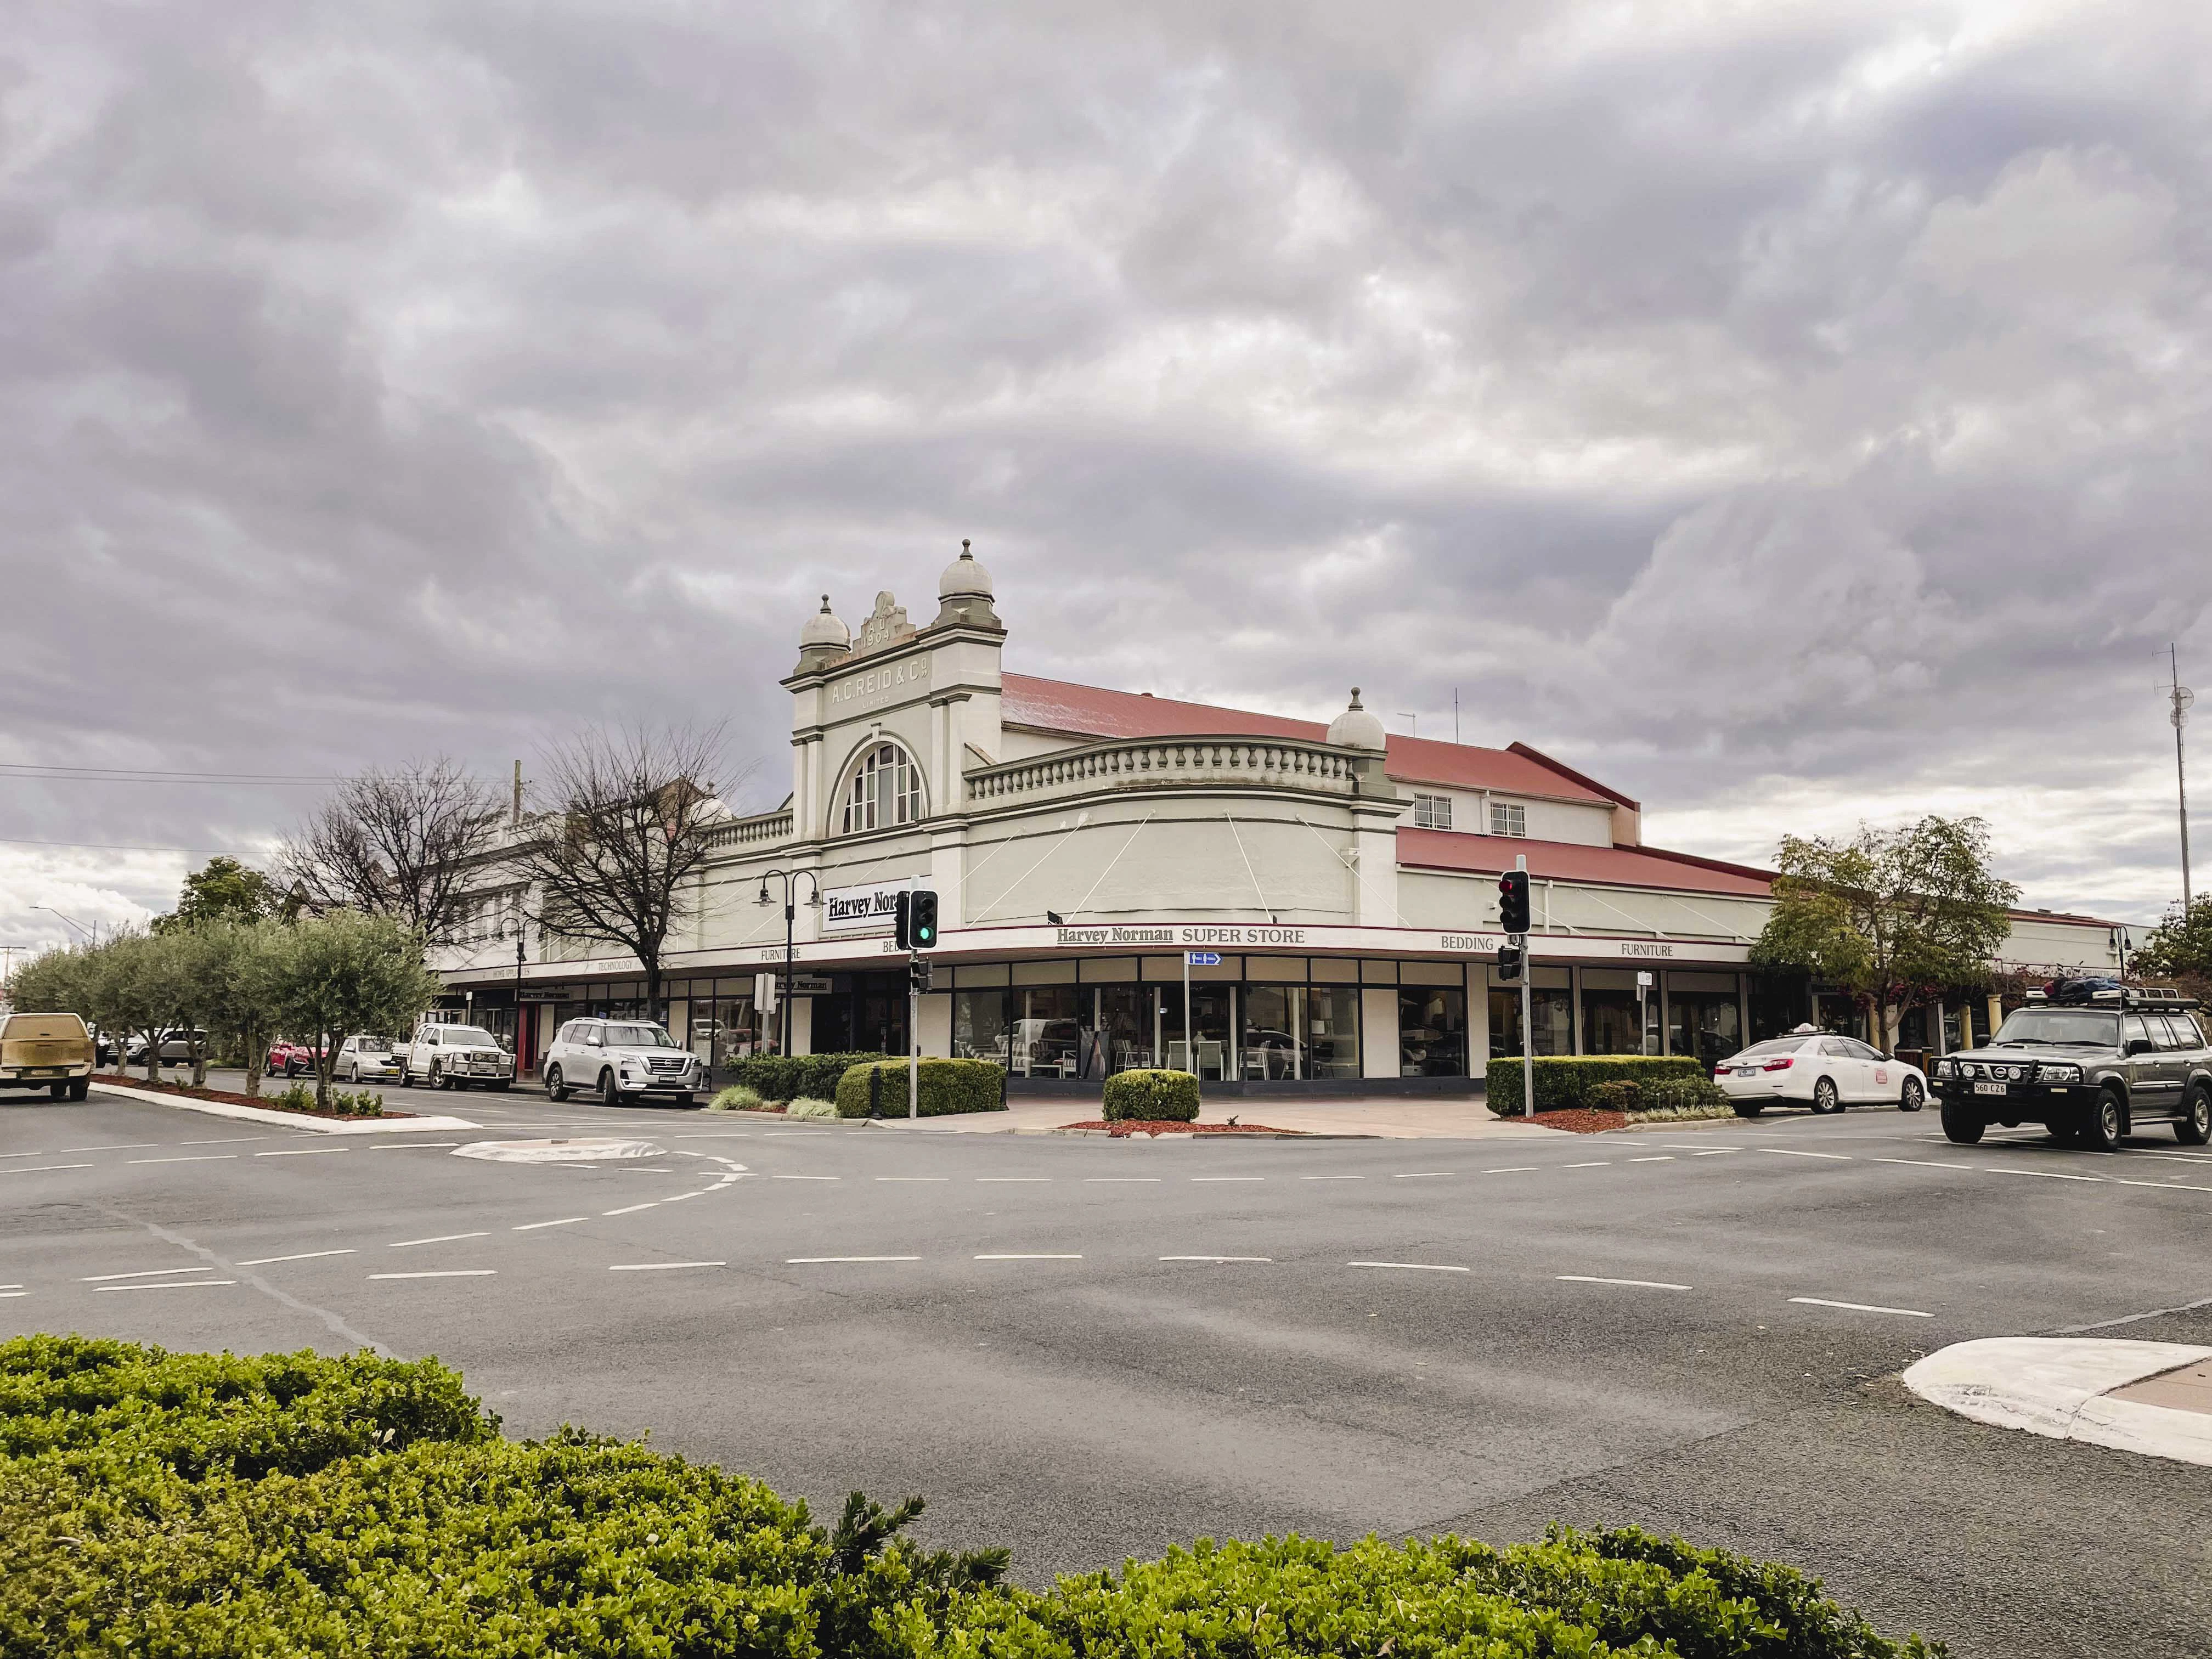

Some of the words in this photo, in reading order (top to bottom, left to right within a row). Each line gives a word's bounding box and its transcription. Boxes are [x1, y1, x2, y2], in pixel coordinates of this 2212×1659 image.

[864, 629, 890, 647] 1904
[896, 665, 905, 685] &
[829, 897, 871, 918] Harvey
[874, 891, 897, 912] Nor
[1057, 928, 1108, 944] Harvey
[1112, 927, 1173, 942] Norman
[1182, 928, 1242, 943] SUPER
[1247, 929, 1305, 943] STORE
[1441, 936, 1494, 951] BEDDING
[1621, 943, 1673, 957] FURNITURE
[761, 947, 801, 960] FURNITRE
[599, 960, 633, 971] TECHNOLOGY
[797, 980, 827, 989] Norman
